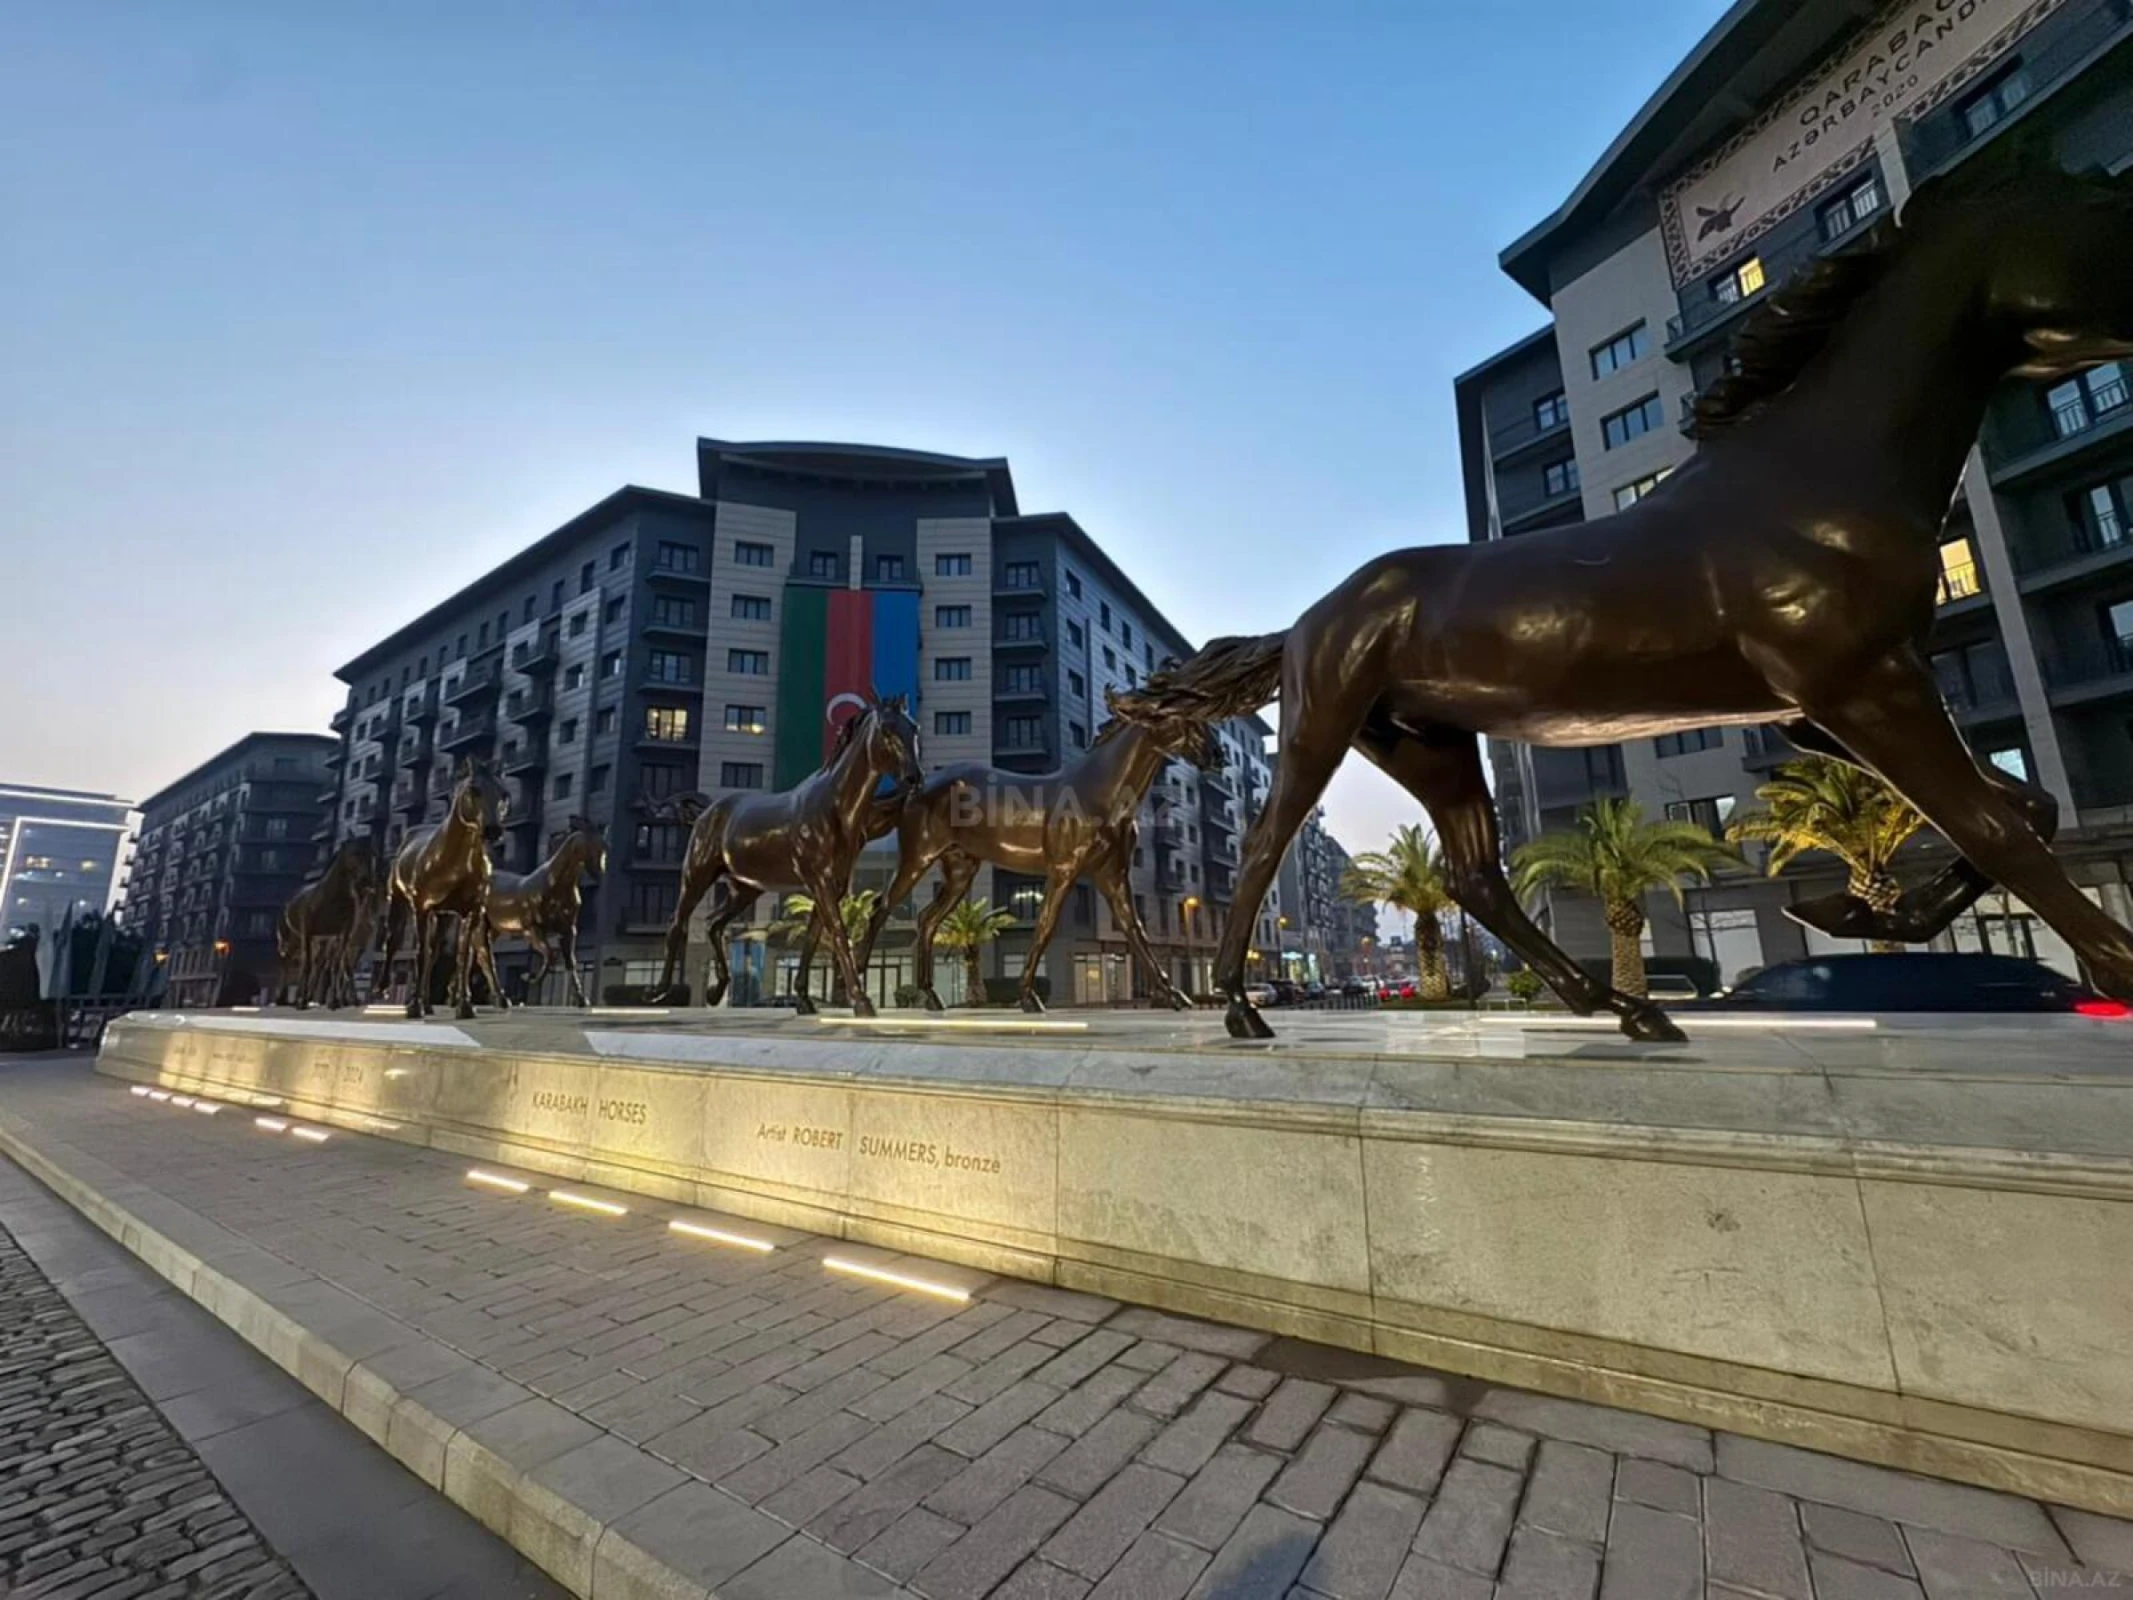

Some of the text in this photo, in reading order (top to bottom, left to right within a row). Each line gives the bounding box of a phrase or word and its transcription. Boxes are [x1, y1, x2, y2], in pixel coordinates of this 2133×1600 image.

[1772, 0, 1986, 172] AZƏRBAYCAND
[533, 1092, 647, 1125] KARABAKH HORSES
[757, 1123, 1001, 1174] Artist ROBERT SUMMERS, bronze
